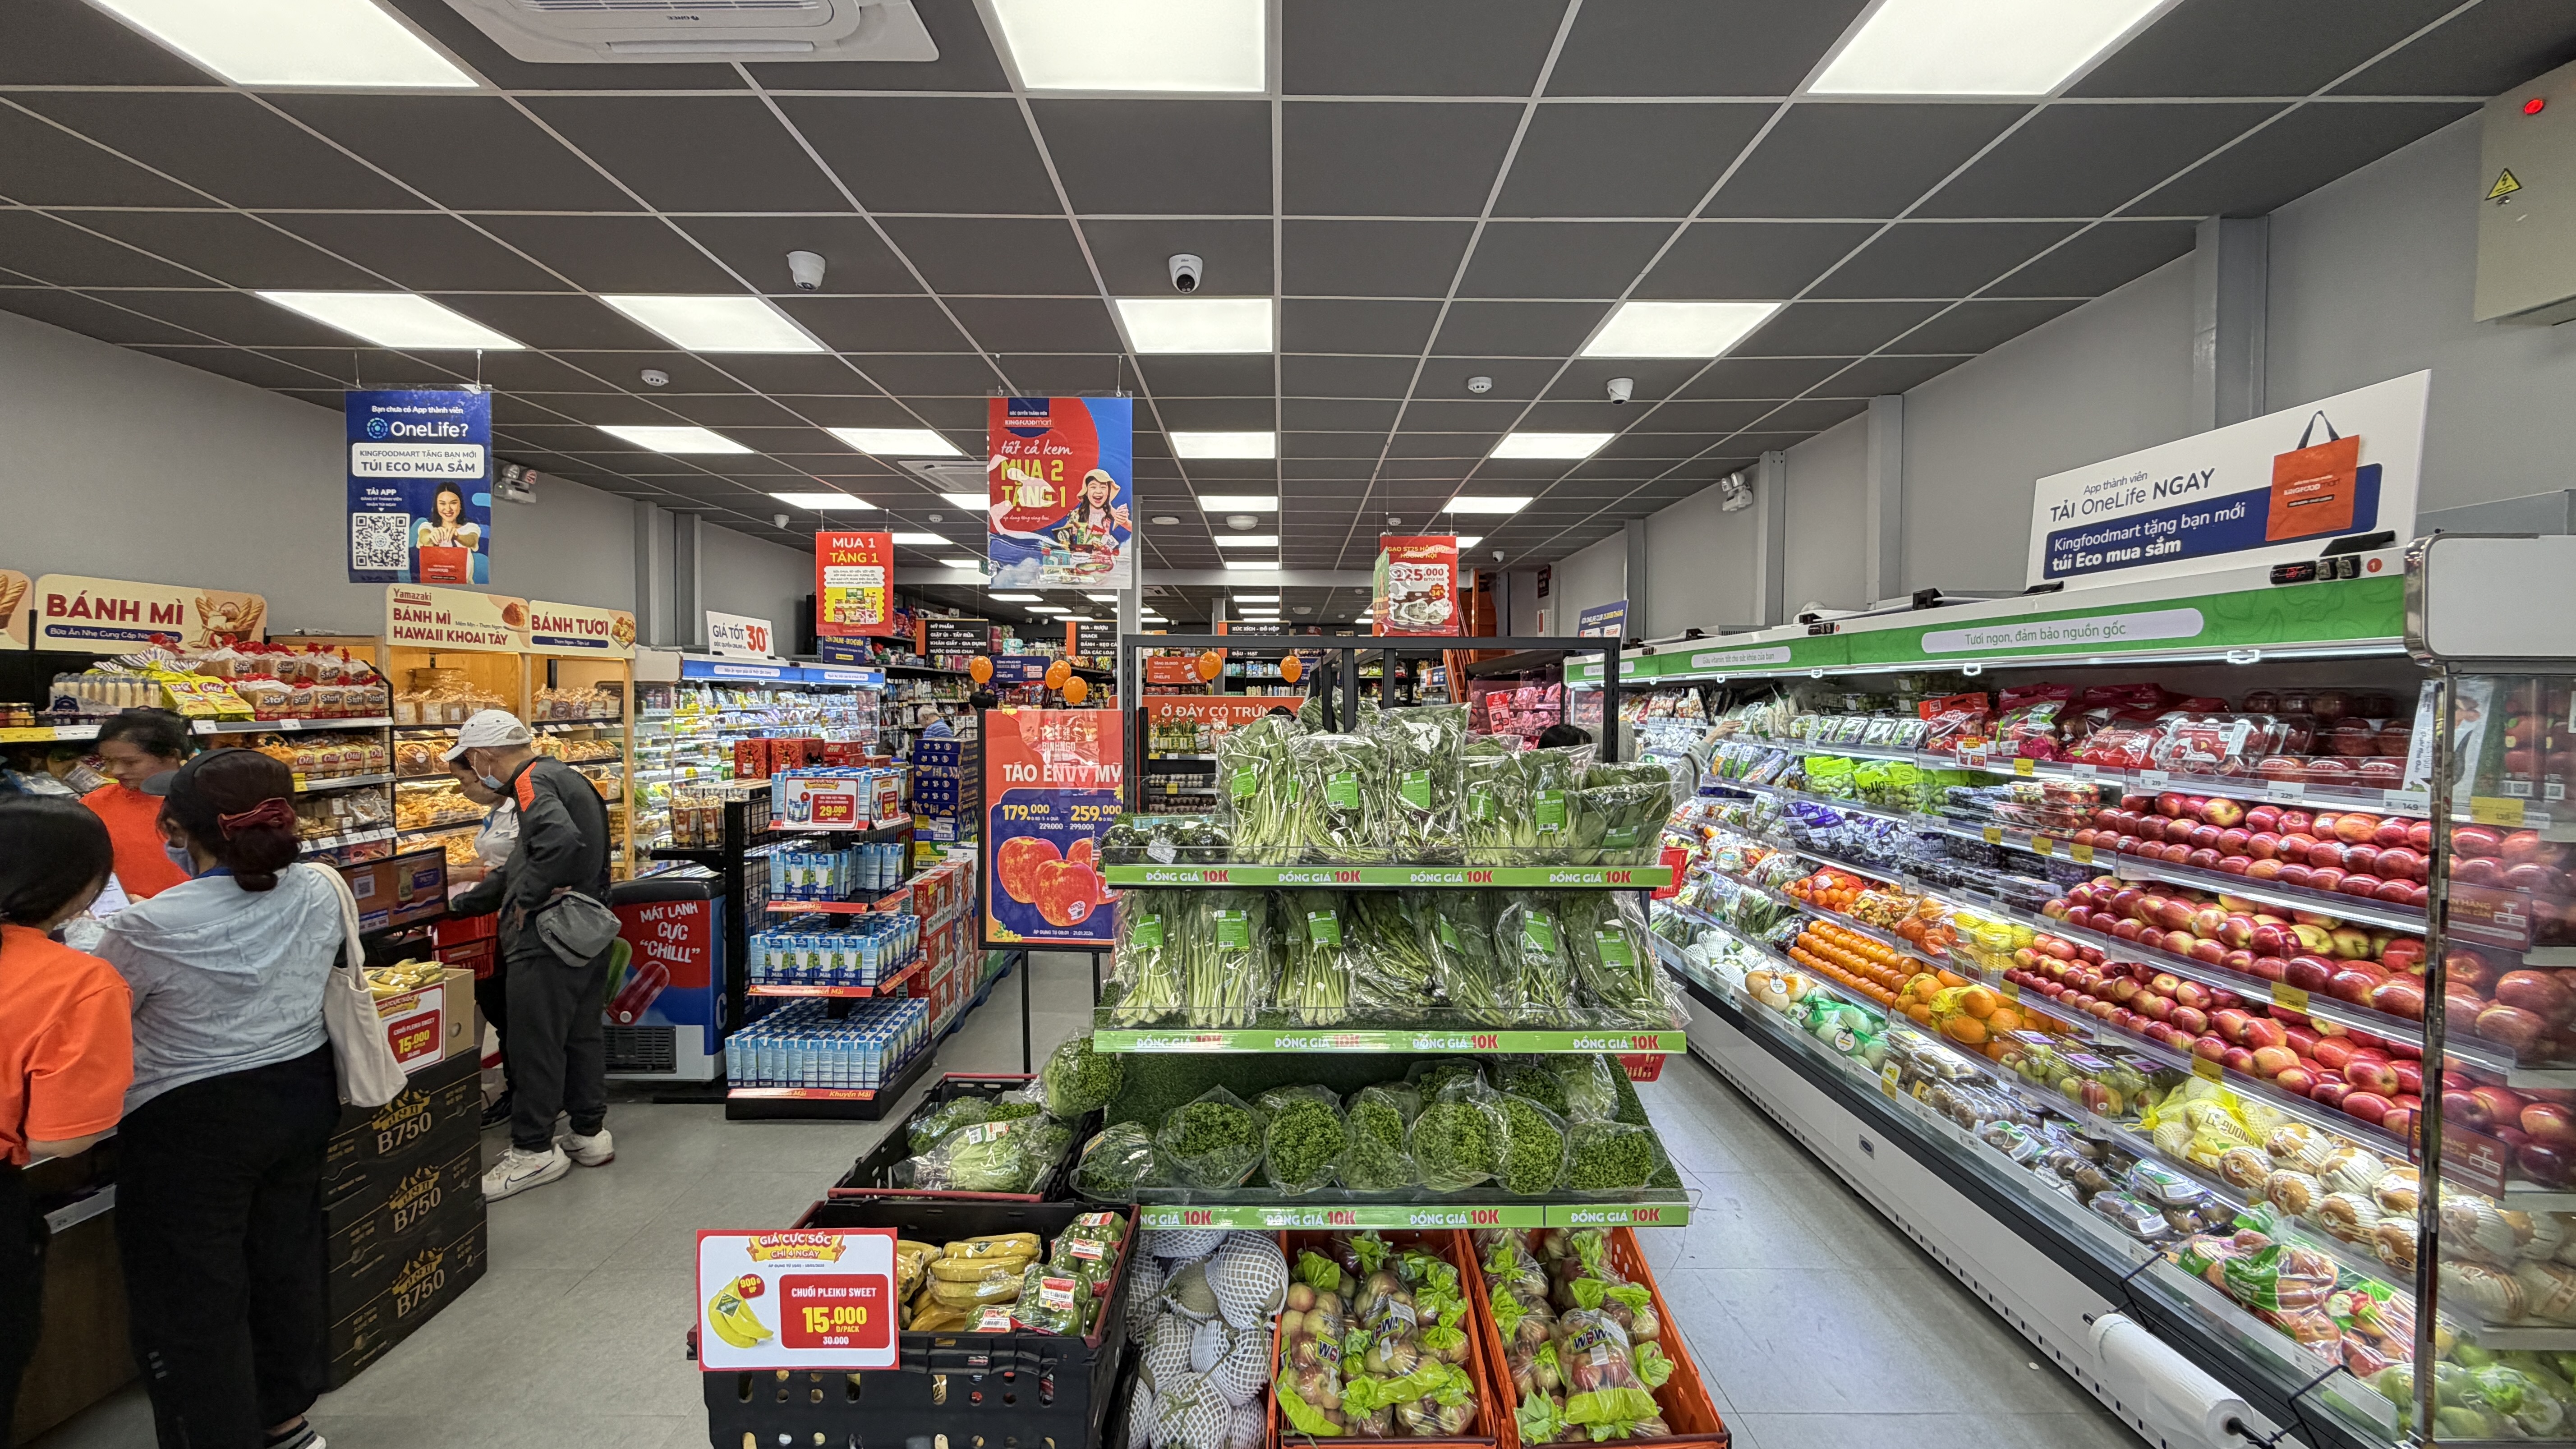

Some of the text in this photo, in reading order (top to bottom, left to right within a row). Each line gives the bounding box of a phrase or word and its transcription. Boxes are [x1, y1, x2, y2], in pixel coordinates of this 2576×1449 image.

[391, 421, 469, 437] OneLife?
[422, 451, 442, 459] TẶNG
[1001, 439, 1073, 455] tất cả kem
[361, 459, 475, 473] TÚI ECO MUA SẮM
[1001, 459, 1064, 481] MUA 2
[366, 487, 378, 495] TẢI
[2084, 471, 2148, 495] App thành viên
[1001, 479, 1066, 511] TẶNG 1
[2050, 468, 2215, 522] TẢI OneLife NGAY
[2055, 502, 2245, 551] Kingfoodmart tặng bạn mới
[833, 537, 876, 548] MUA 1
[829, 550, 879, 565] TẶNG 1
[2052, 536, 2181, 570] túi Eco mua sắm
[393, 588, 432, 602] Yamazaki
[46, 590, 184, 625] BÁNH MÌ
[393, 606, 451, 625] BÁNH MÌ
[531, 611, 609, 636] BÁNH TƯƠI
[713, 623, 727, 637] GIÁ
[728, 624, 744, 640] TỐT
[68, 627, 81, 636] Ăn
[82, 630, 97, 638] Nhẹ
[100, 630, 120, 639] Cung
[121, 631, 136, 639] Cấp
[393, 626, 508, 645] HAWAII KHOAI TÂY
[1965, 620, 2126, 645] Tươi ngon, đảm bảo nguồn gốc
[1161, 703, 1271, 717] Ở ĐÂY CÓ TRỨN
[1003, 761, 1122, 782] TÁO ENVY MỸ
[819, 805, 846, 816] 29.000
[1003, 805, 1122, 821] 179.000 259.000
[1146, 870, 1631, 883] ĐỒNG GIÁ 10K ĐỒNG GIÁ 10K
[640, 902, 698, 923] MÁT LẠNH
[658, 921, 688, 943] CỰC
[931, 957, 952, 985] Heineken
[398, 1029, 430, 1054] 15.000
[1573, 1035, 1660, 1049] ĐỒNG GIÁ 10K
[377, 1112, 431, 1154] B750
[394, 1187, 441, 1233] B750
[1140, 1210, 1500, 1225] NG GIÁ 10K ĐỒNG GIÁ 10K
[1571, 1209, 1661, 1223] ĐỒNG GIÁ 10K
[759, 1231, 832, 1246] GIÁ CỰC SỐC
[795, 1248, 820, 1258] NGÀY
[397, 1269, 445, 1320] B750
[791, 1285, 877, 1297] CHUỐI PLEIKU SWEET
[802, 1306, 867, 1334] 15.000
[823, 1336, 850, 1345] 30.000
